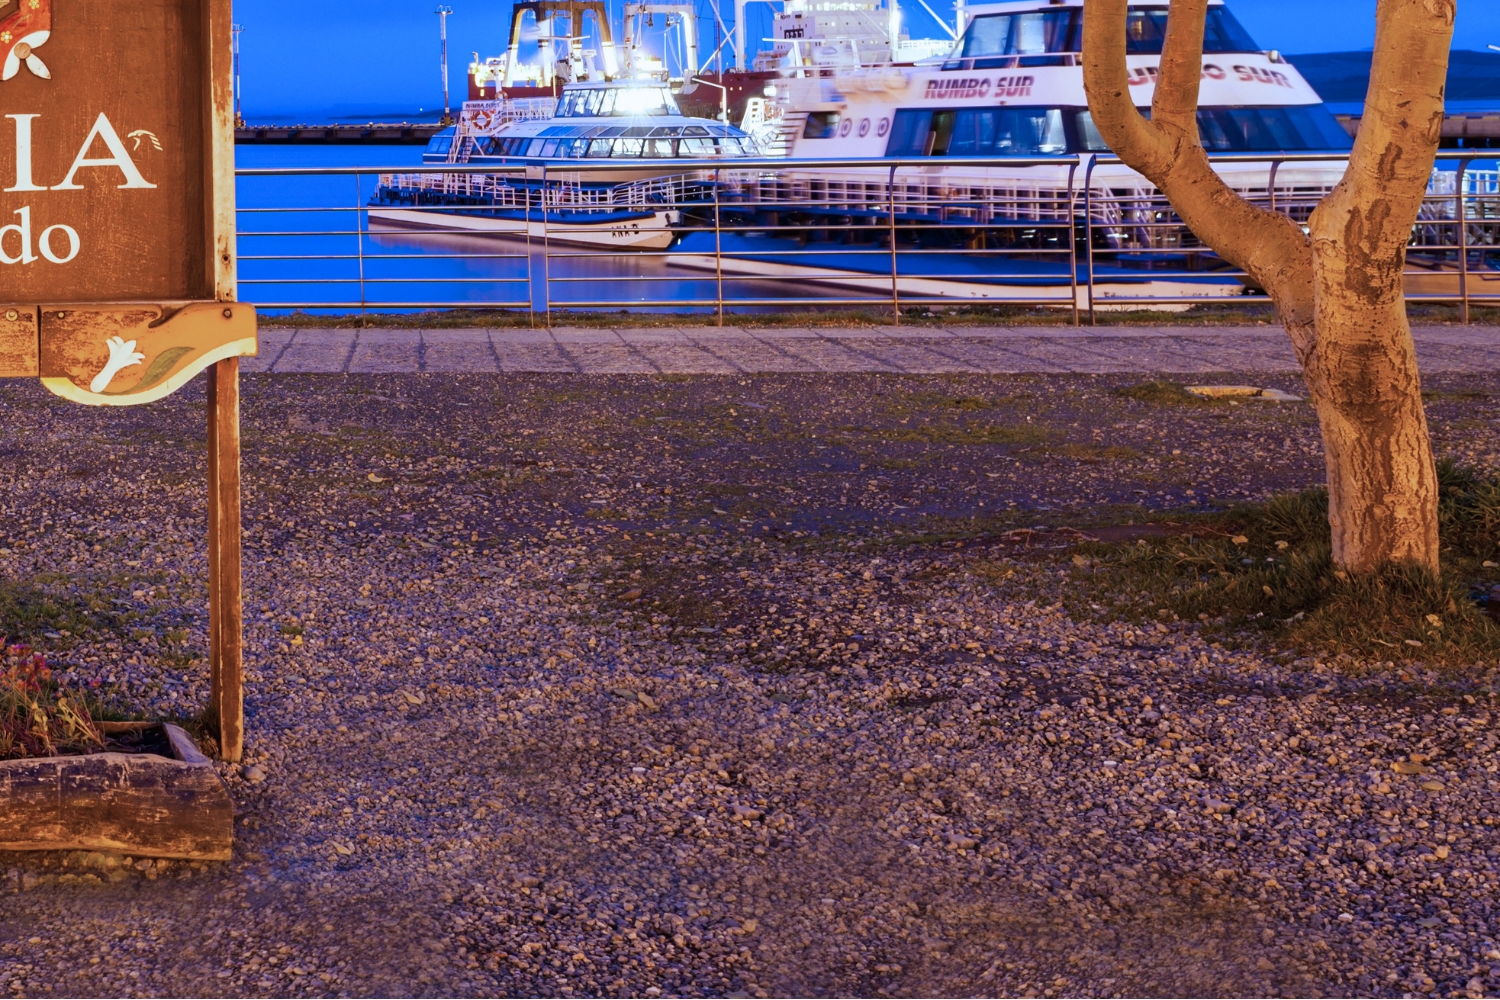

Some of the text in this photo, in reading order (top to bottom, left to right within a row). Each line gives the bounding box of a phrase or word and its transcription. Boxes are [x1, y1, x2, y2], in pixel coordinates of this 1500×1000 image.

[924, 76, 1034, 99] RUMBO SUR
[1232, 64, 1293, 88] SUR
